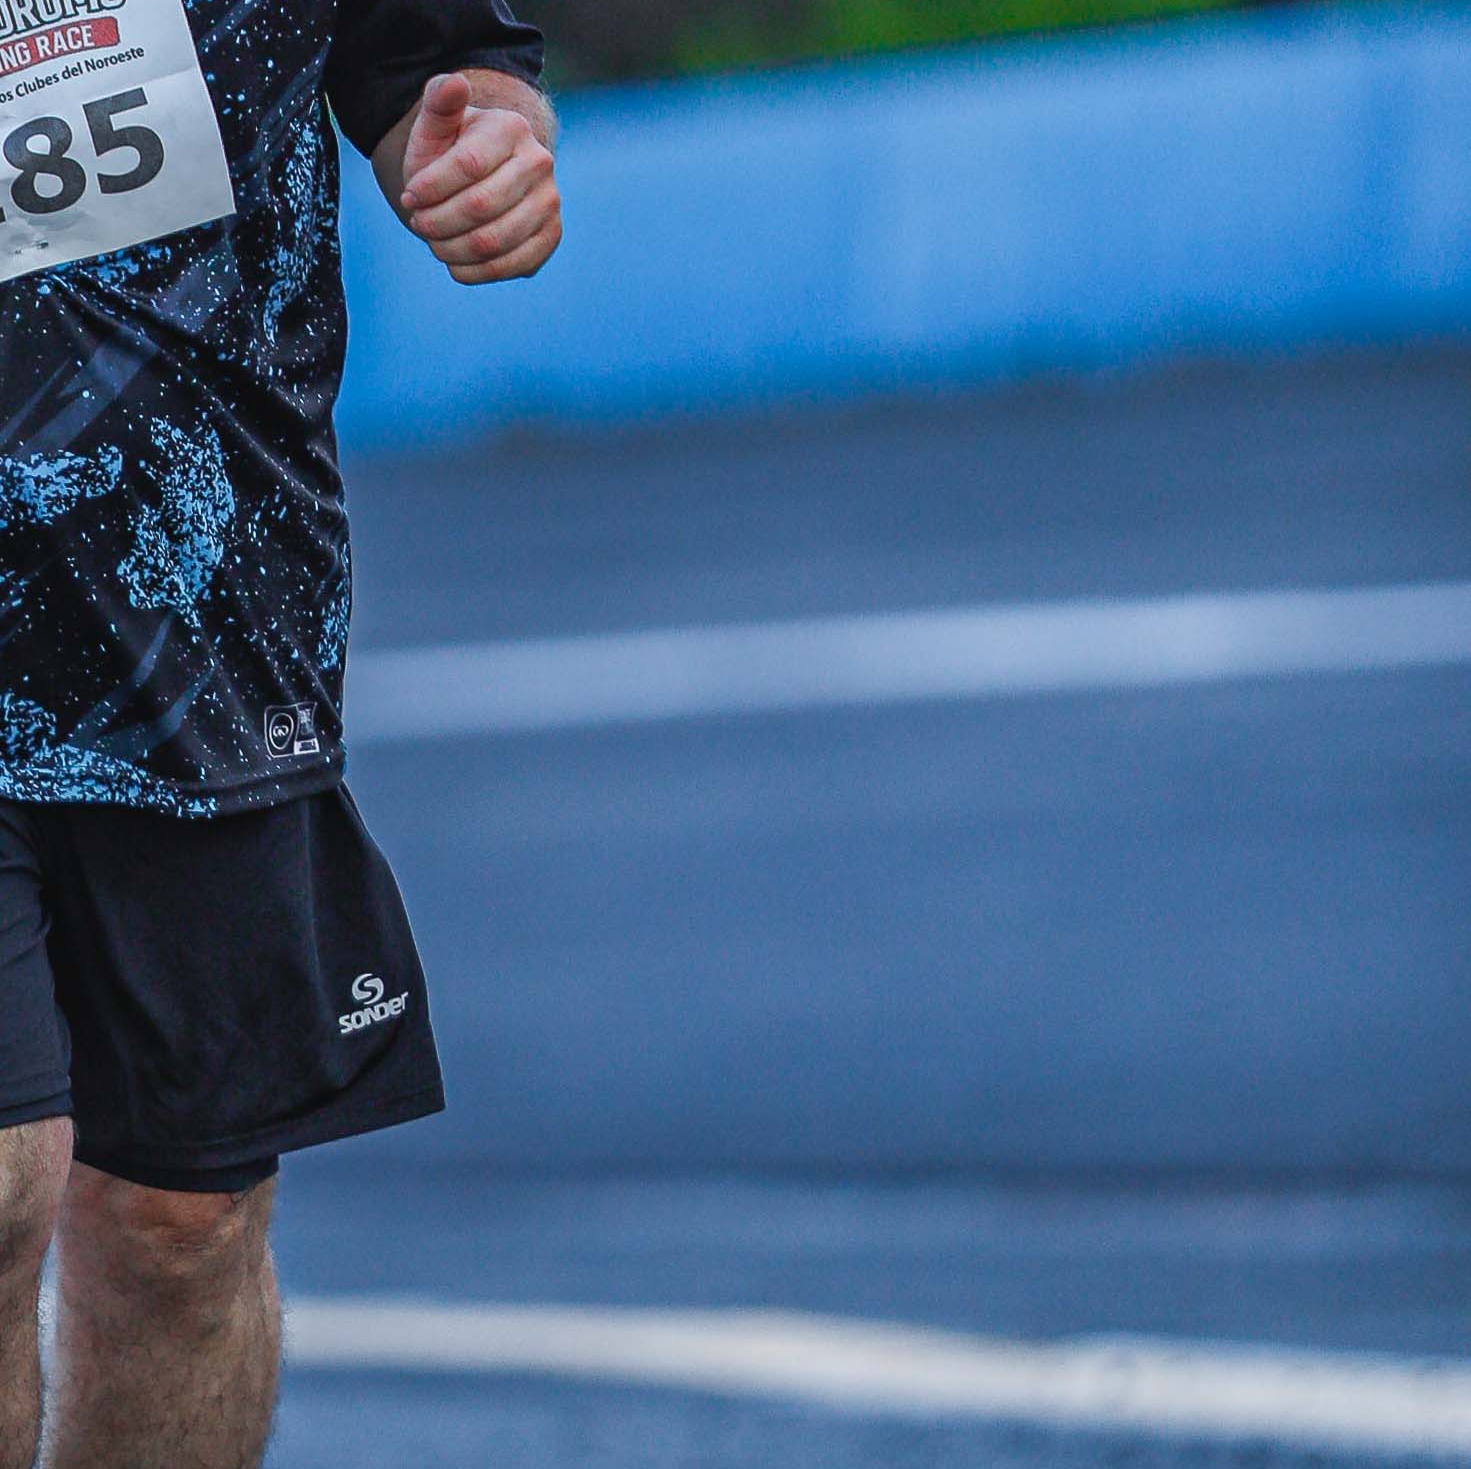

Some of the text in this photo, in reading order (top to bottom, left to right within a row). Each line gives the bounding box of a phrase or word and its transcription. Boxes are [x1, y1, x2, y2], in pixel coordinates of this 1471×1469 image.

[36, 24, 95, 59] RACE
[15, 72, 60, 98] Clubes
[62, 63, 84, 81] del
[85, 45, 145, 73] Noroeste
